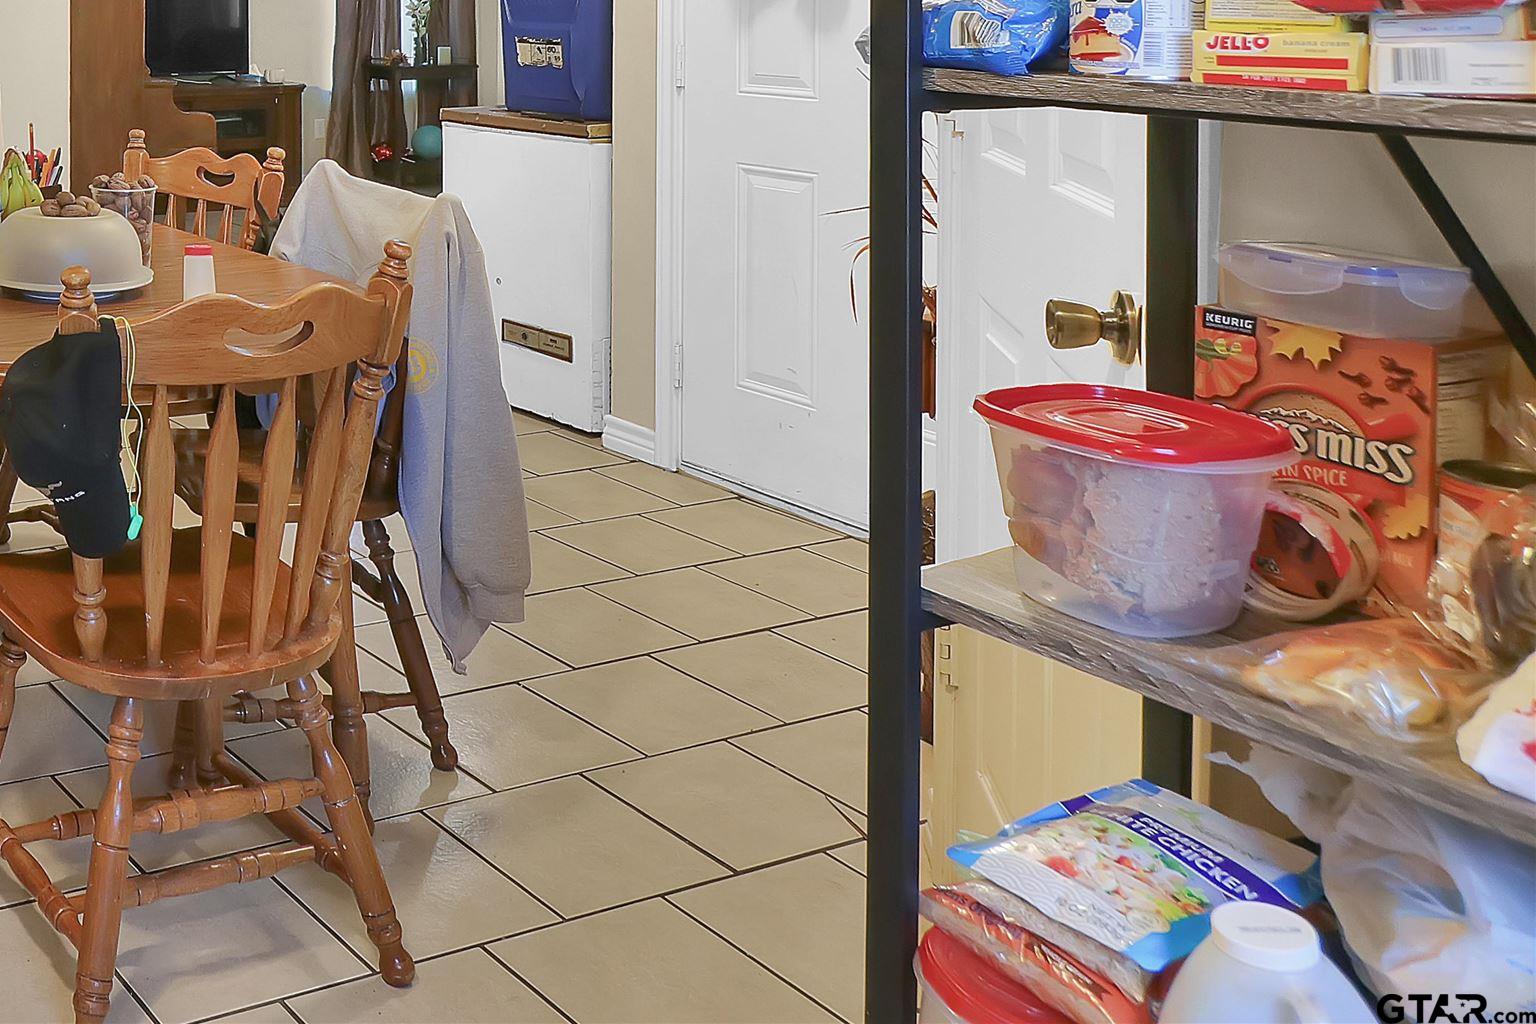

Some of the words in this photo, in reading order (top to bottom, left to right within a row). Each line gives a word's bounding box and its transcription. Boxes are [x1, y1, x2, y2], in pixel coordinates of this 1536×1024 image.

[1282, 39, 1318, 47] banana
[1205, 312, 1255, 329] KEURIG
[1316, 428, 1415, 484] MISS
[1305, 464, 1349, 487] SPICE
[1138, 816, 1225, 863] PREMIUM
[1157, 835, 1259, 901] CHICKEN
